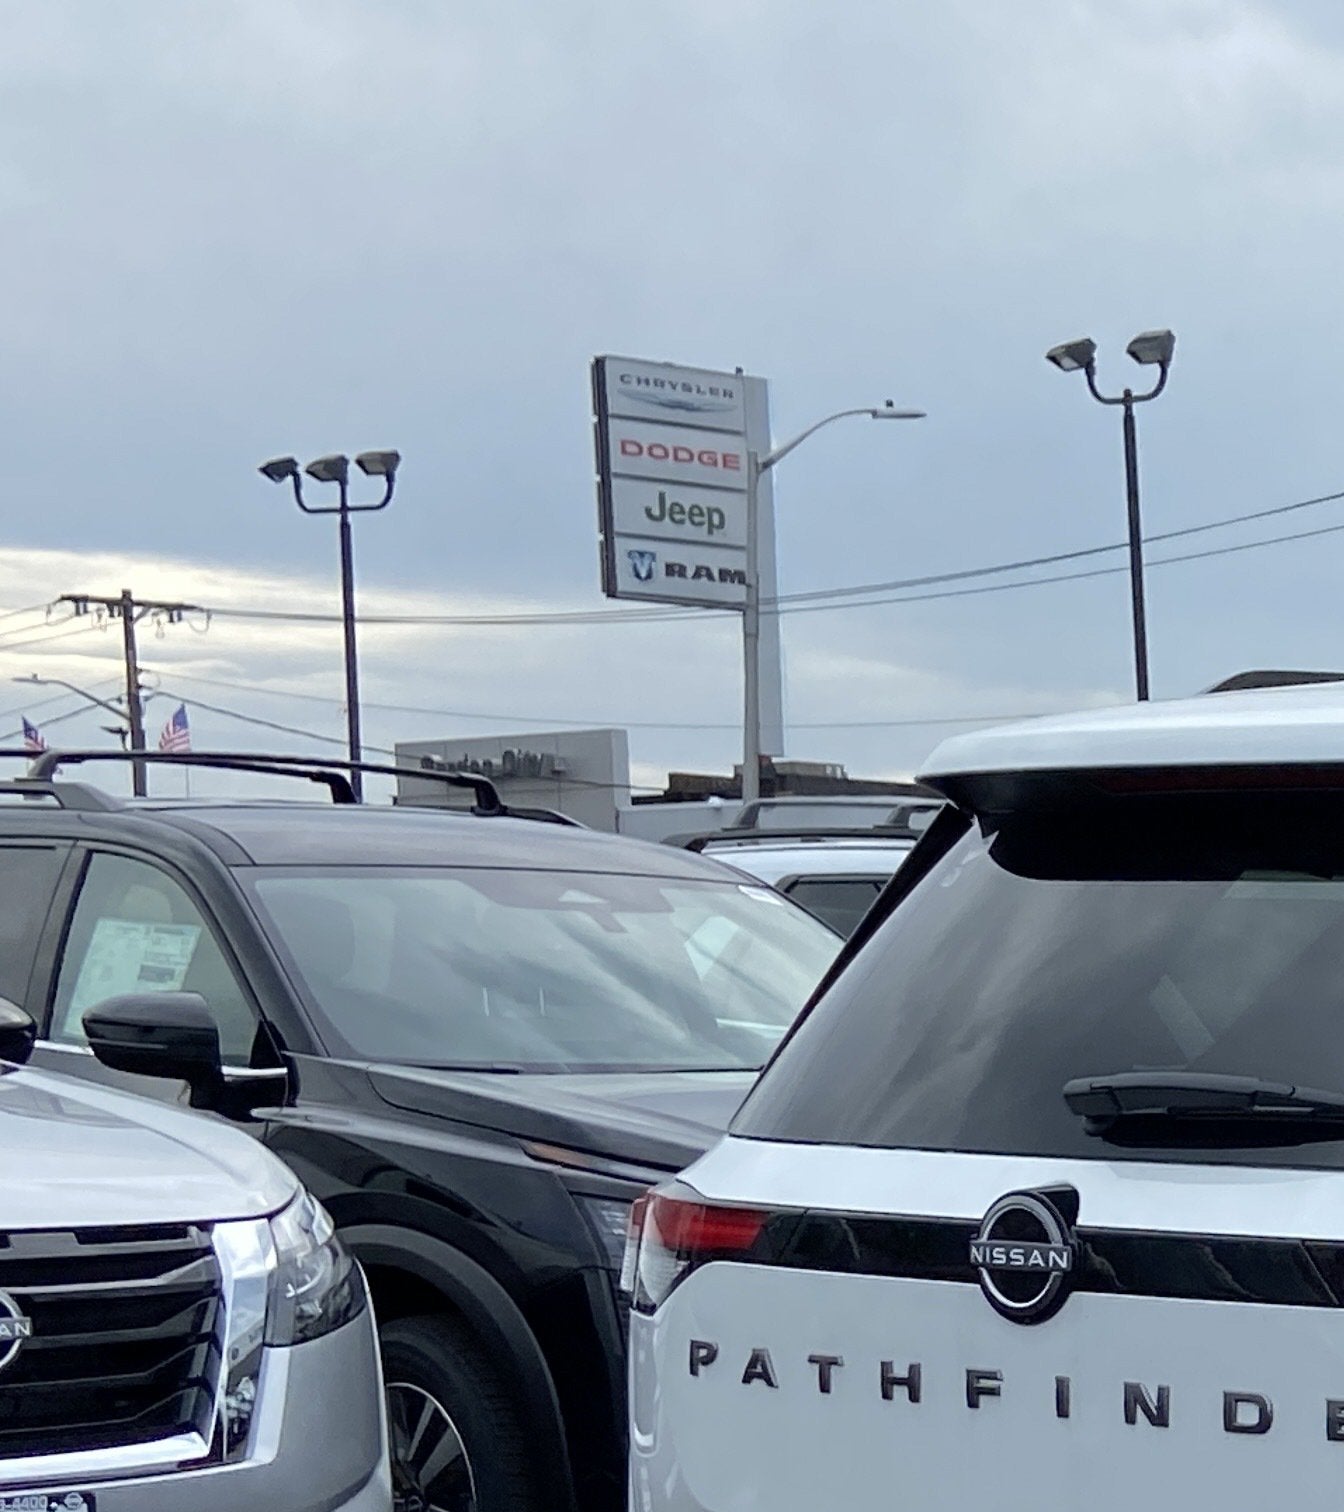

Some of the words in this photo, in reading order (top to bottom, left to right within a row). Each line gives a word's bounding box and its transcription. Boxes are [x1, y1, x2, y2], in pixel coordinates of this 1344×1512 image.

[619, 373, 735, 399] CHRYSLER
[620, 439, 741, 471] DODGE
[644, 491, 726, 535] Jeep
[664, 561, 747, 585] RAM
[969, 1245, 1068, 1269] NISSAN
